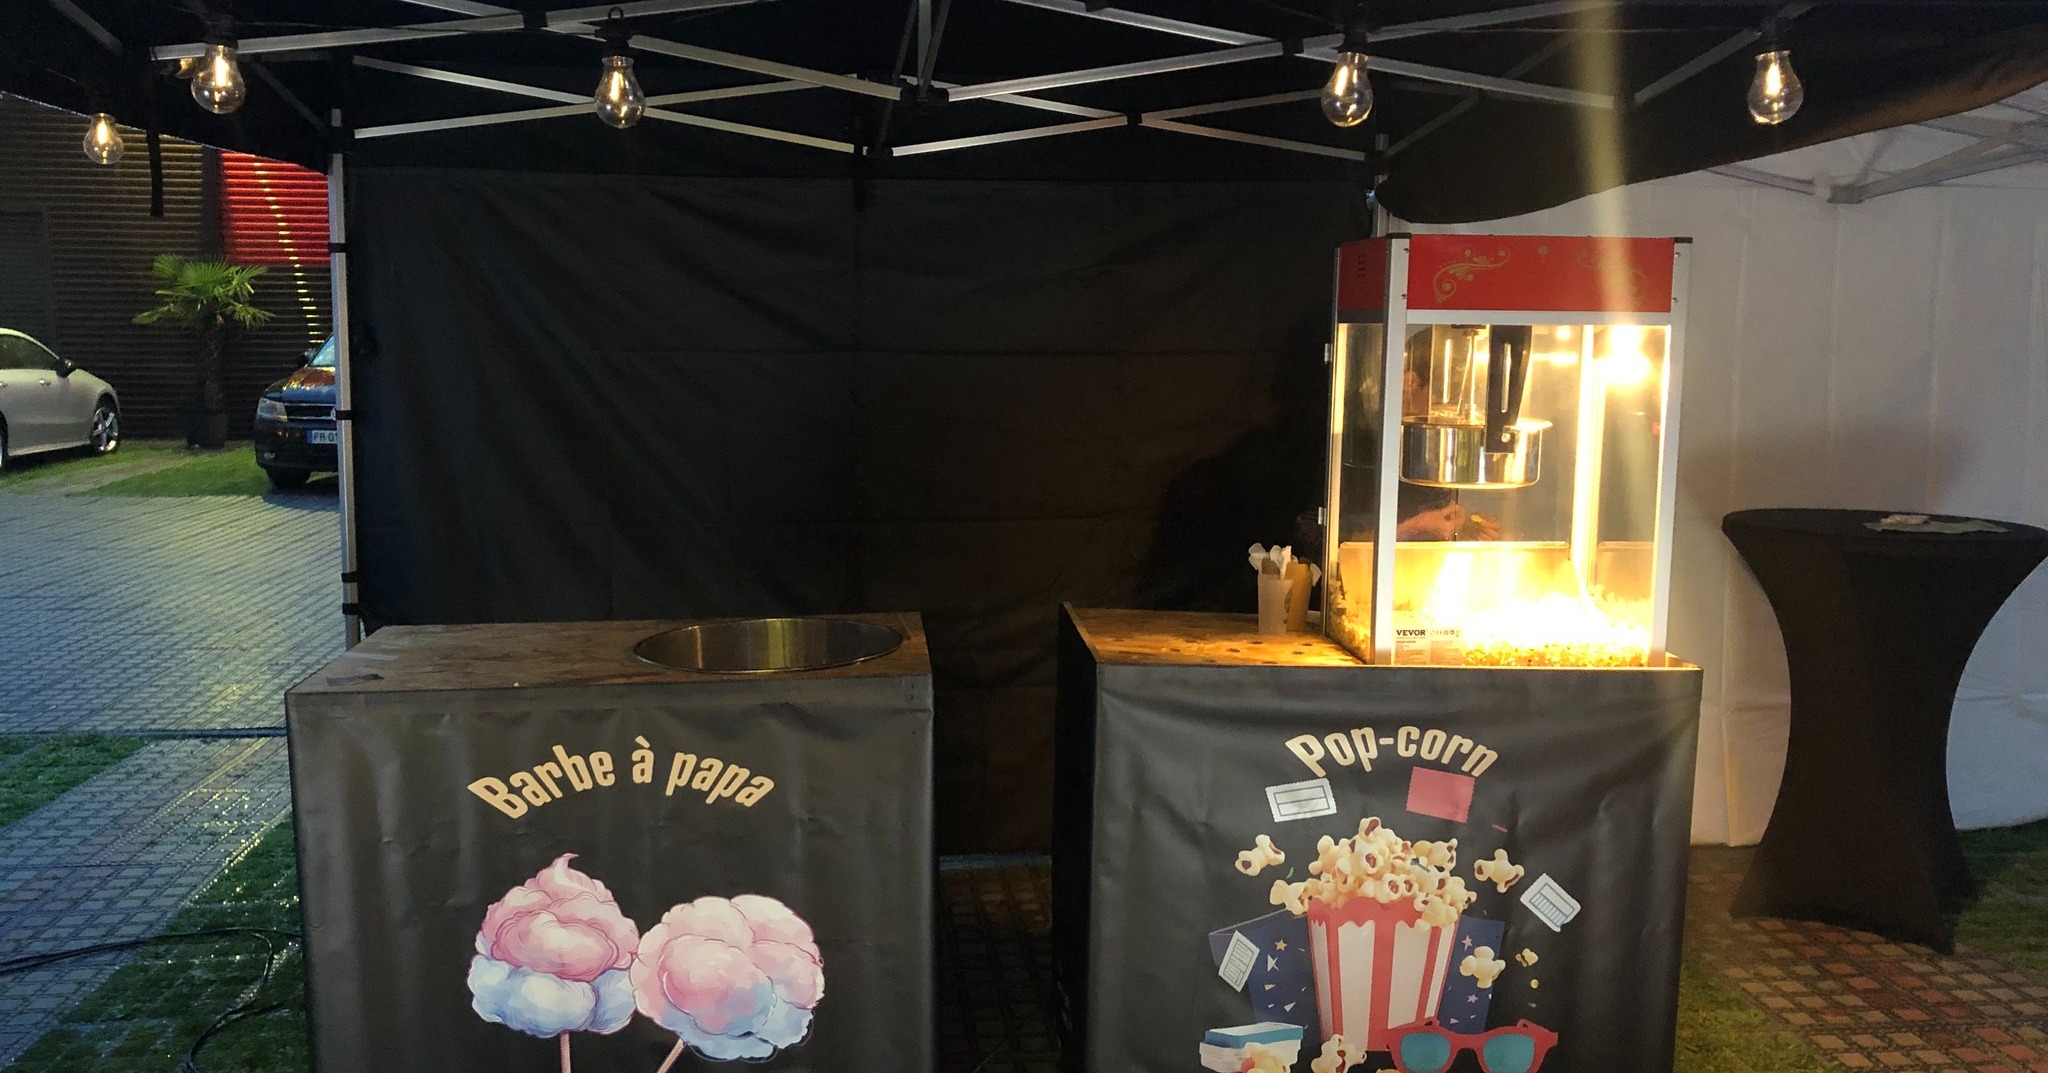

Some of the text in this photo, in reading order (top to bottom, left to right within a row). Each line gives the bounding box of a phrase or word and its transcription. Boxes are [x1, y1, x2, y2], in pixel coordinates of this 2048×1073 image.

[466, 735, 775, 819] Barbe à papa
[1285, 725, 1499, 778] Pop-corn
